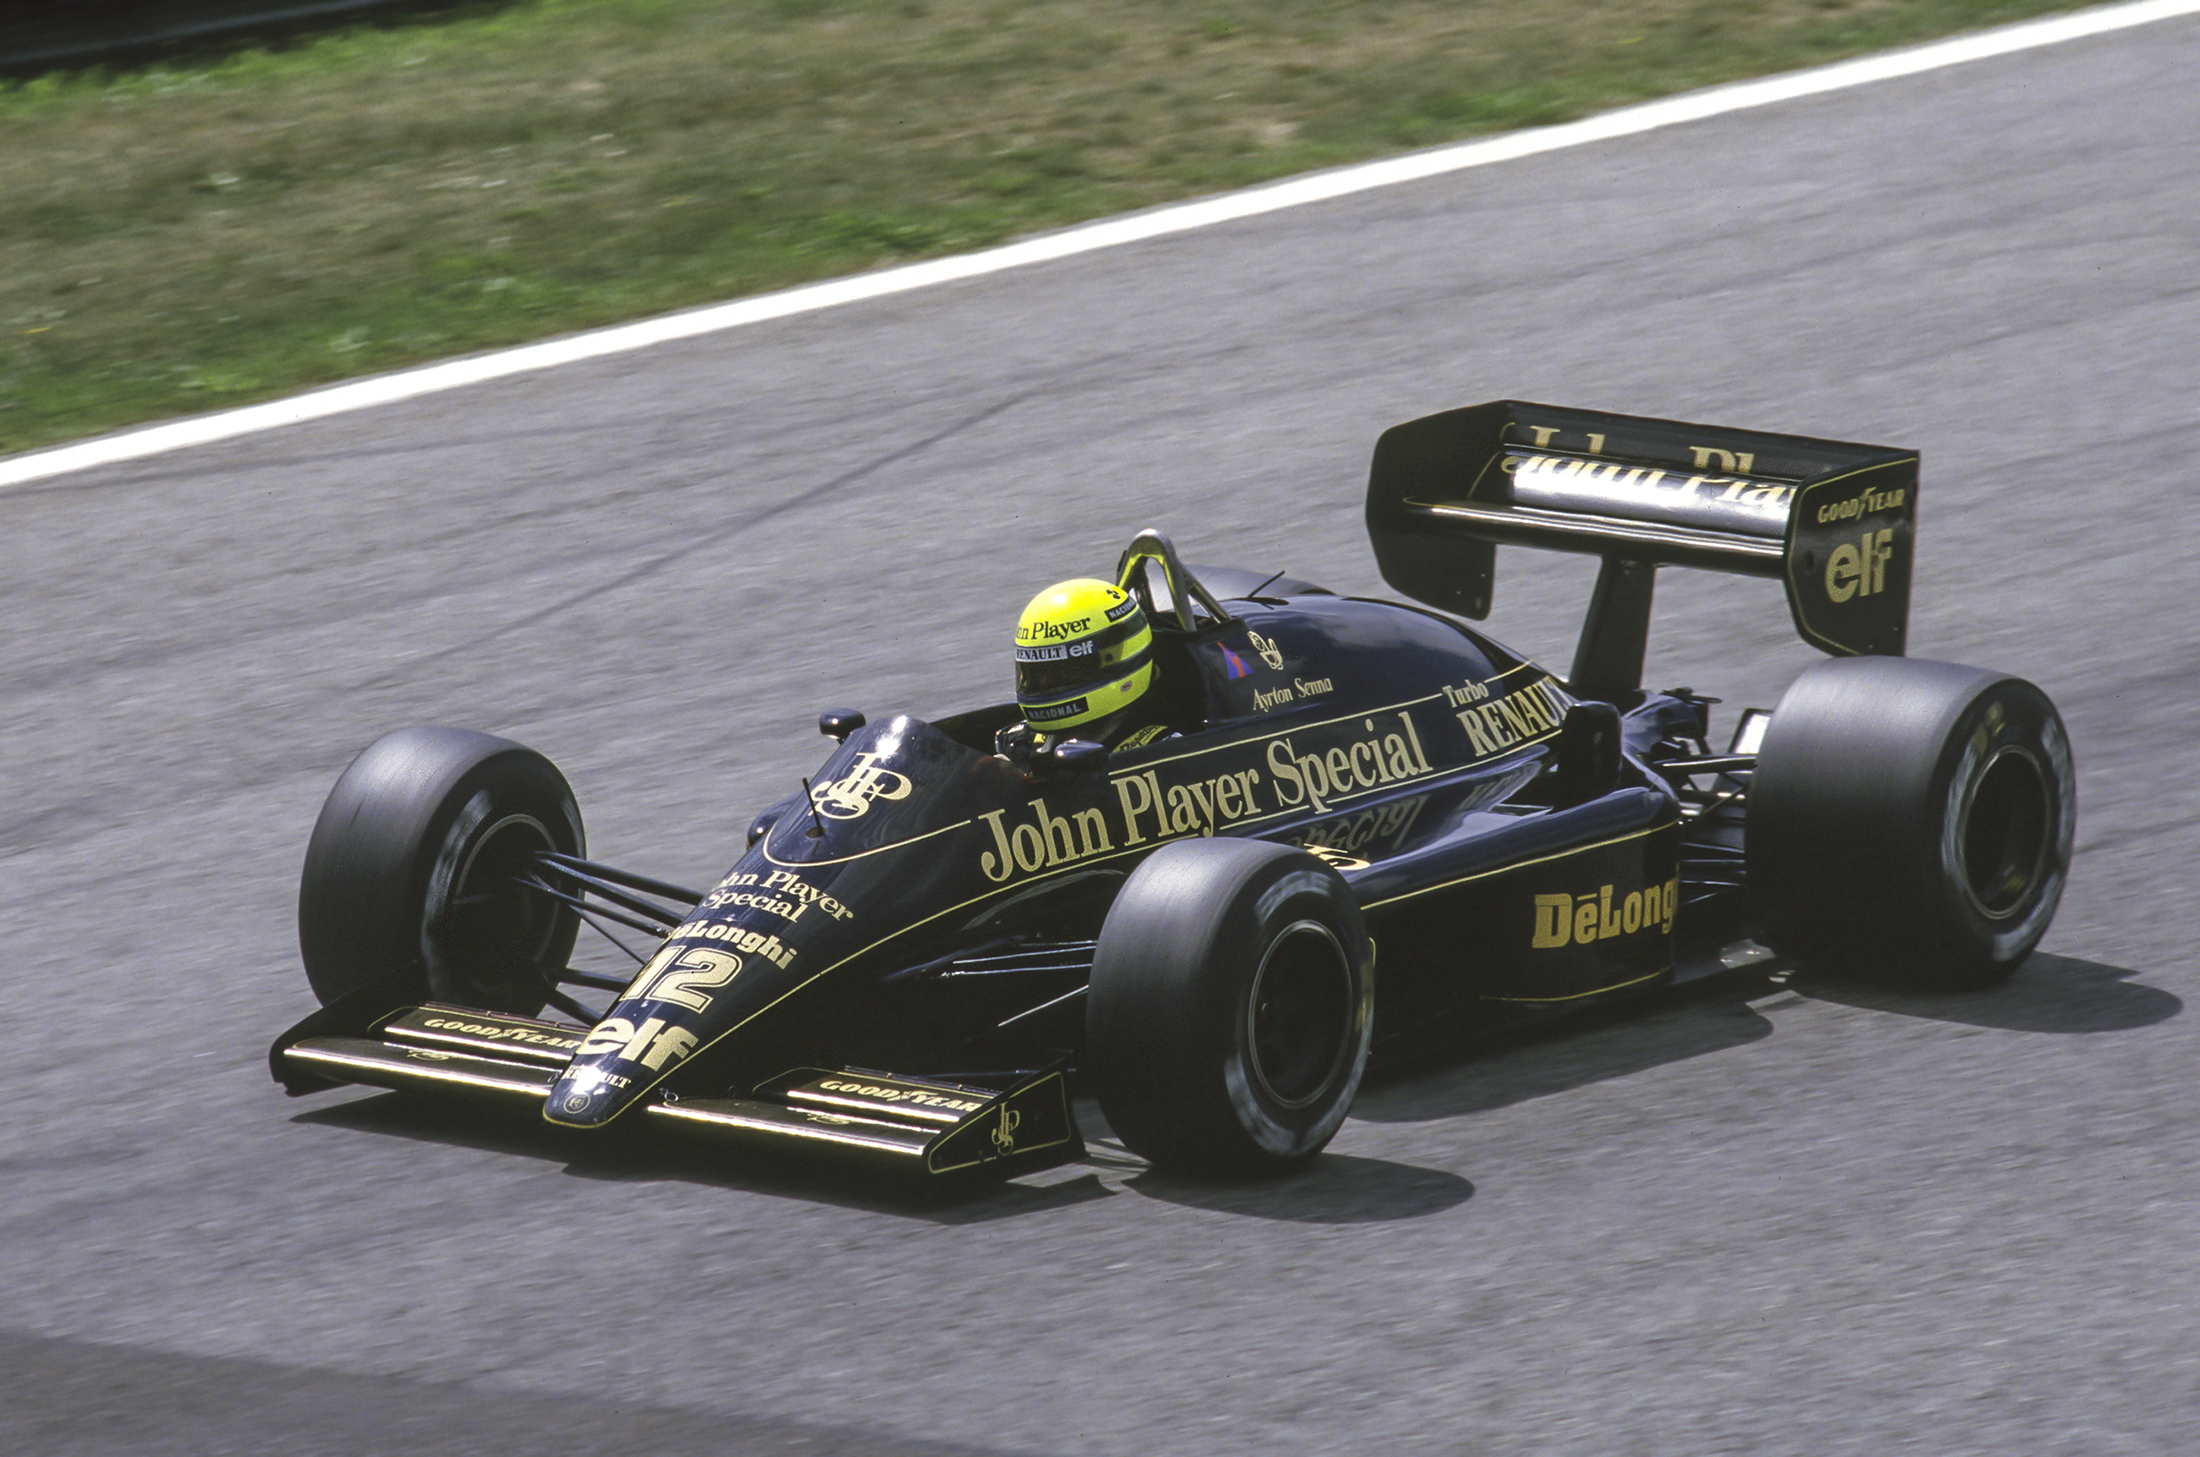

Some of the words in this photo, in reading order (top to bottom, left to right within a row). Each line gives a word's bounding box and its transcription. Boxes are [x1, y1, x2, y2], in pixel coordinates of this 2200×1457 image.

[1817, 486, 1905, 523] GOODYEAR
[1825, 528, 1893, 603] elf
[1031, 617, 1091, 640] Player
[1069, 640, 1093, 657] elf
[1028, 702, 1082, 720] NACIONAL
[1253, 687, 1294, 713] Ayrton
[1294, 677, 1334, 698] Senna
[1442, 679, 1489, 708] Turbo
[981, 798, 1115, 883] John
[1110, 767, 1261, 838] Player
[1267, 711, 1433, 815] Special
[702, 888, 808, 923] Special
[760, 870, 854, 921] Player
[619, 945, 743, 1014] 12
[424, 1018, 583, 1050] GOODYEAR
[576, 1017, 699, 1072] elf
[820, 1079, 983, 1112] GOODYEAR
